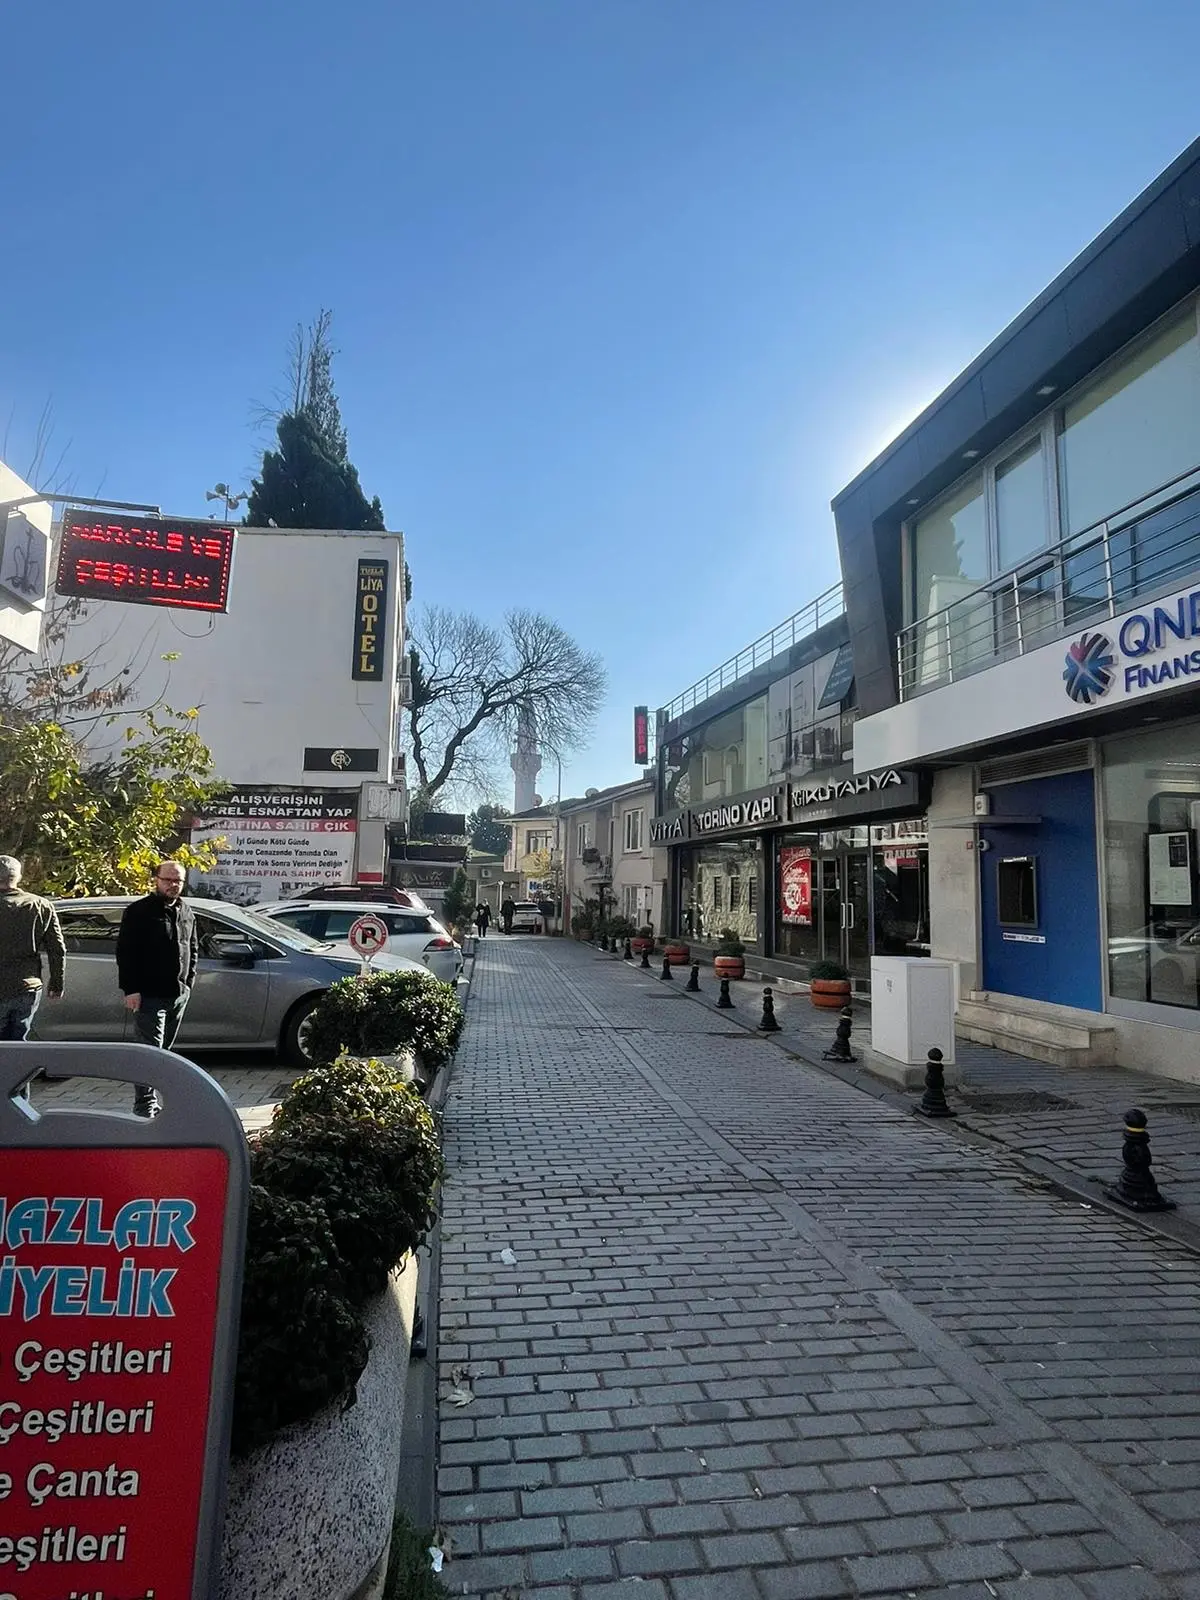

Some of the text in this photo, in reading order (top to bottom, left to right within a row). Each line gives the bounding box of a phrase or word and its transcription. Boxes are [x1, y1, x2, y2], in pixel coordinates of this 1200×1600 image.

[361, 576, 384, 591] LİYA
[360, 594, 378, 672] OTEL
[230, 794, 323, 806] ALIŞVERİŞİNİ
[248, 806, 322, 817] ESNAFTAN
[326, 808, 353, 817] YAP
[742, 795, 775, 822] YAPI
[275, 821, 319, 831] SAHİP
[324, 822, 349, 833] ÇIK
[650, 818, 683, 841] VitrA
[0, 1197, 197, 1253] AZLAR
[14, 1340, 172, 1382] Çeşitleri
[0, 1400, 154, 1444] Çeşitleri
[26, 1462, 139, 1507] Çanta
